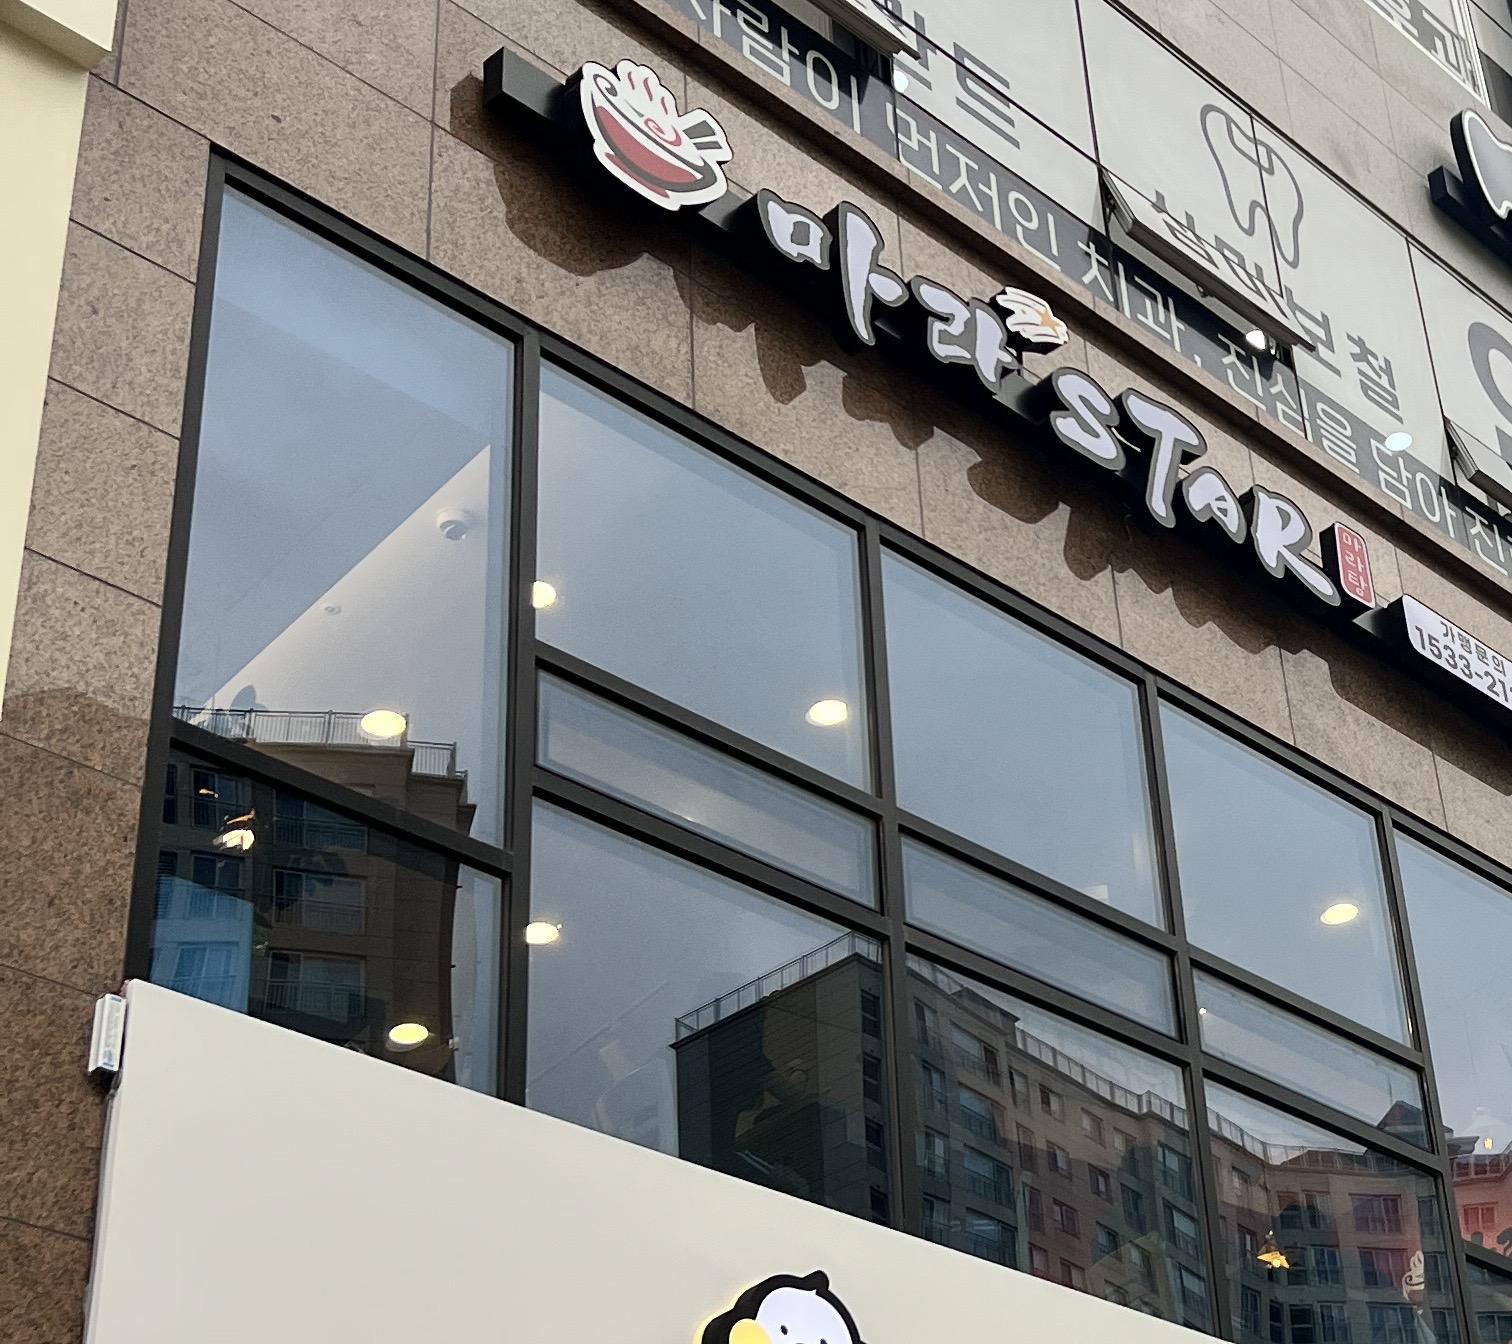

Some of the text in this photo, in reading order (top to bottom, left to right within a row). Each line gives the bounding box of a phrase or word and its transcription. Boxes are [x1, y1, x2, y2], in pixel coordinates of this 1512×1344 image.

[756, 186, 1020, 388] 마라
[1340, 526, 1371, 604] 마라탕
[885, 100, 1063, 273] 먼저인
[1219, 340, 1362, 484] 진심을
[1375, 438, 1461, 531] 담아
[1439, 620, 1508, 678] 가맹문의
